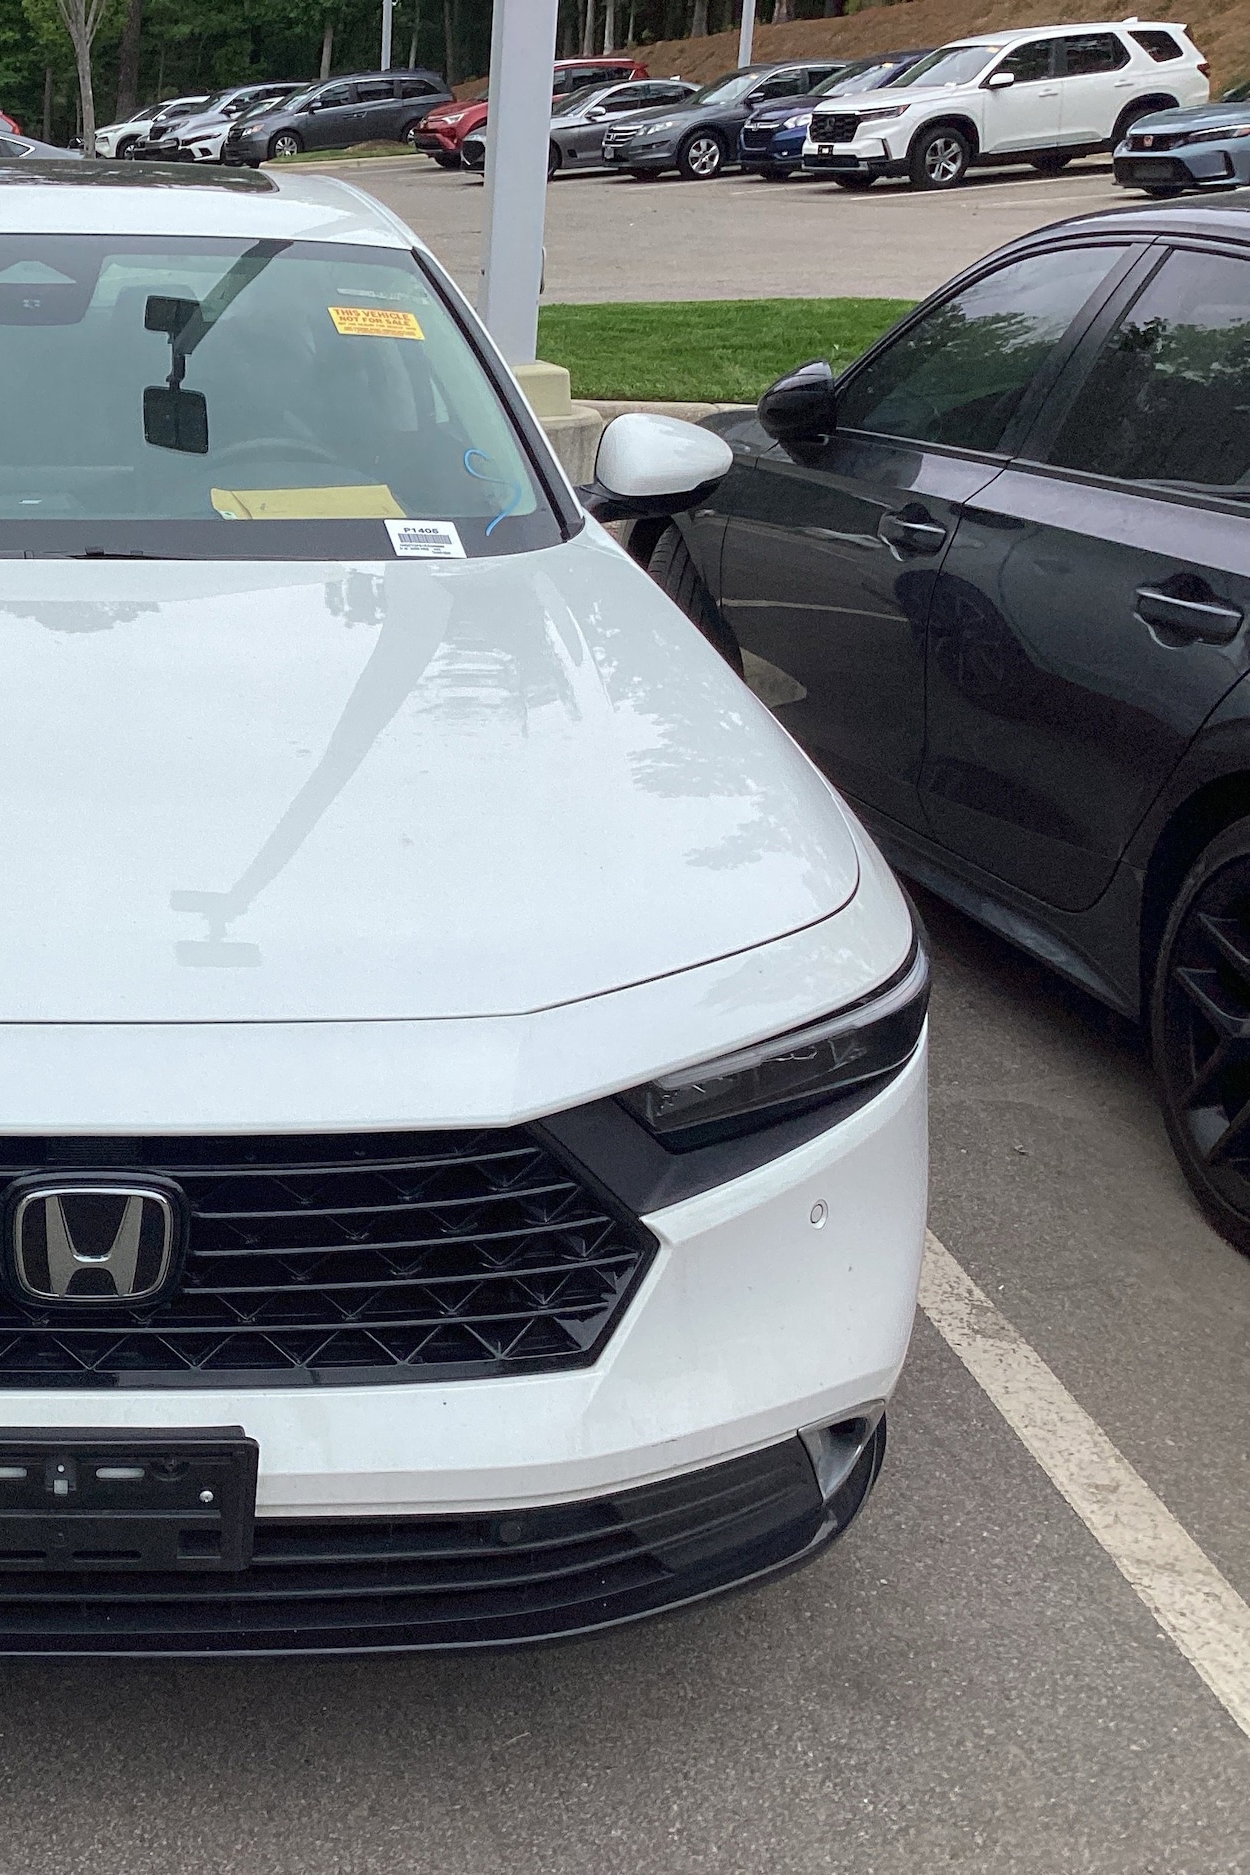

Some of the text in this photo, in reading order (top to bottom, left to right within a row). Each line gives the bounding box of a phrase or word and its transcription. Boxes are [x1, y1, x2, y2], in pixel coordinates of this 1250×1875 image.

[333, 309, 410, 320] THIS VEHICLE
[385, 319, 410, 327] SALE
